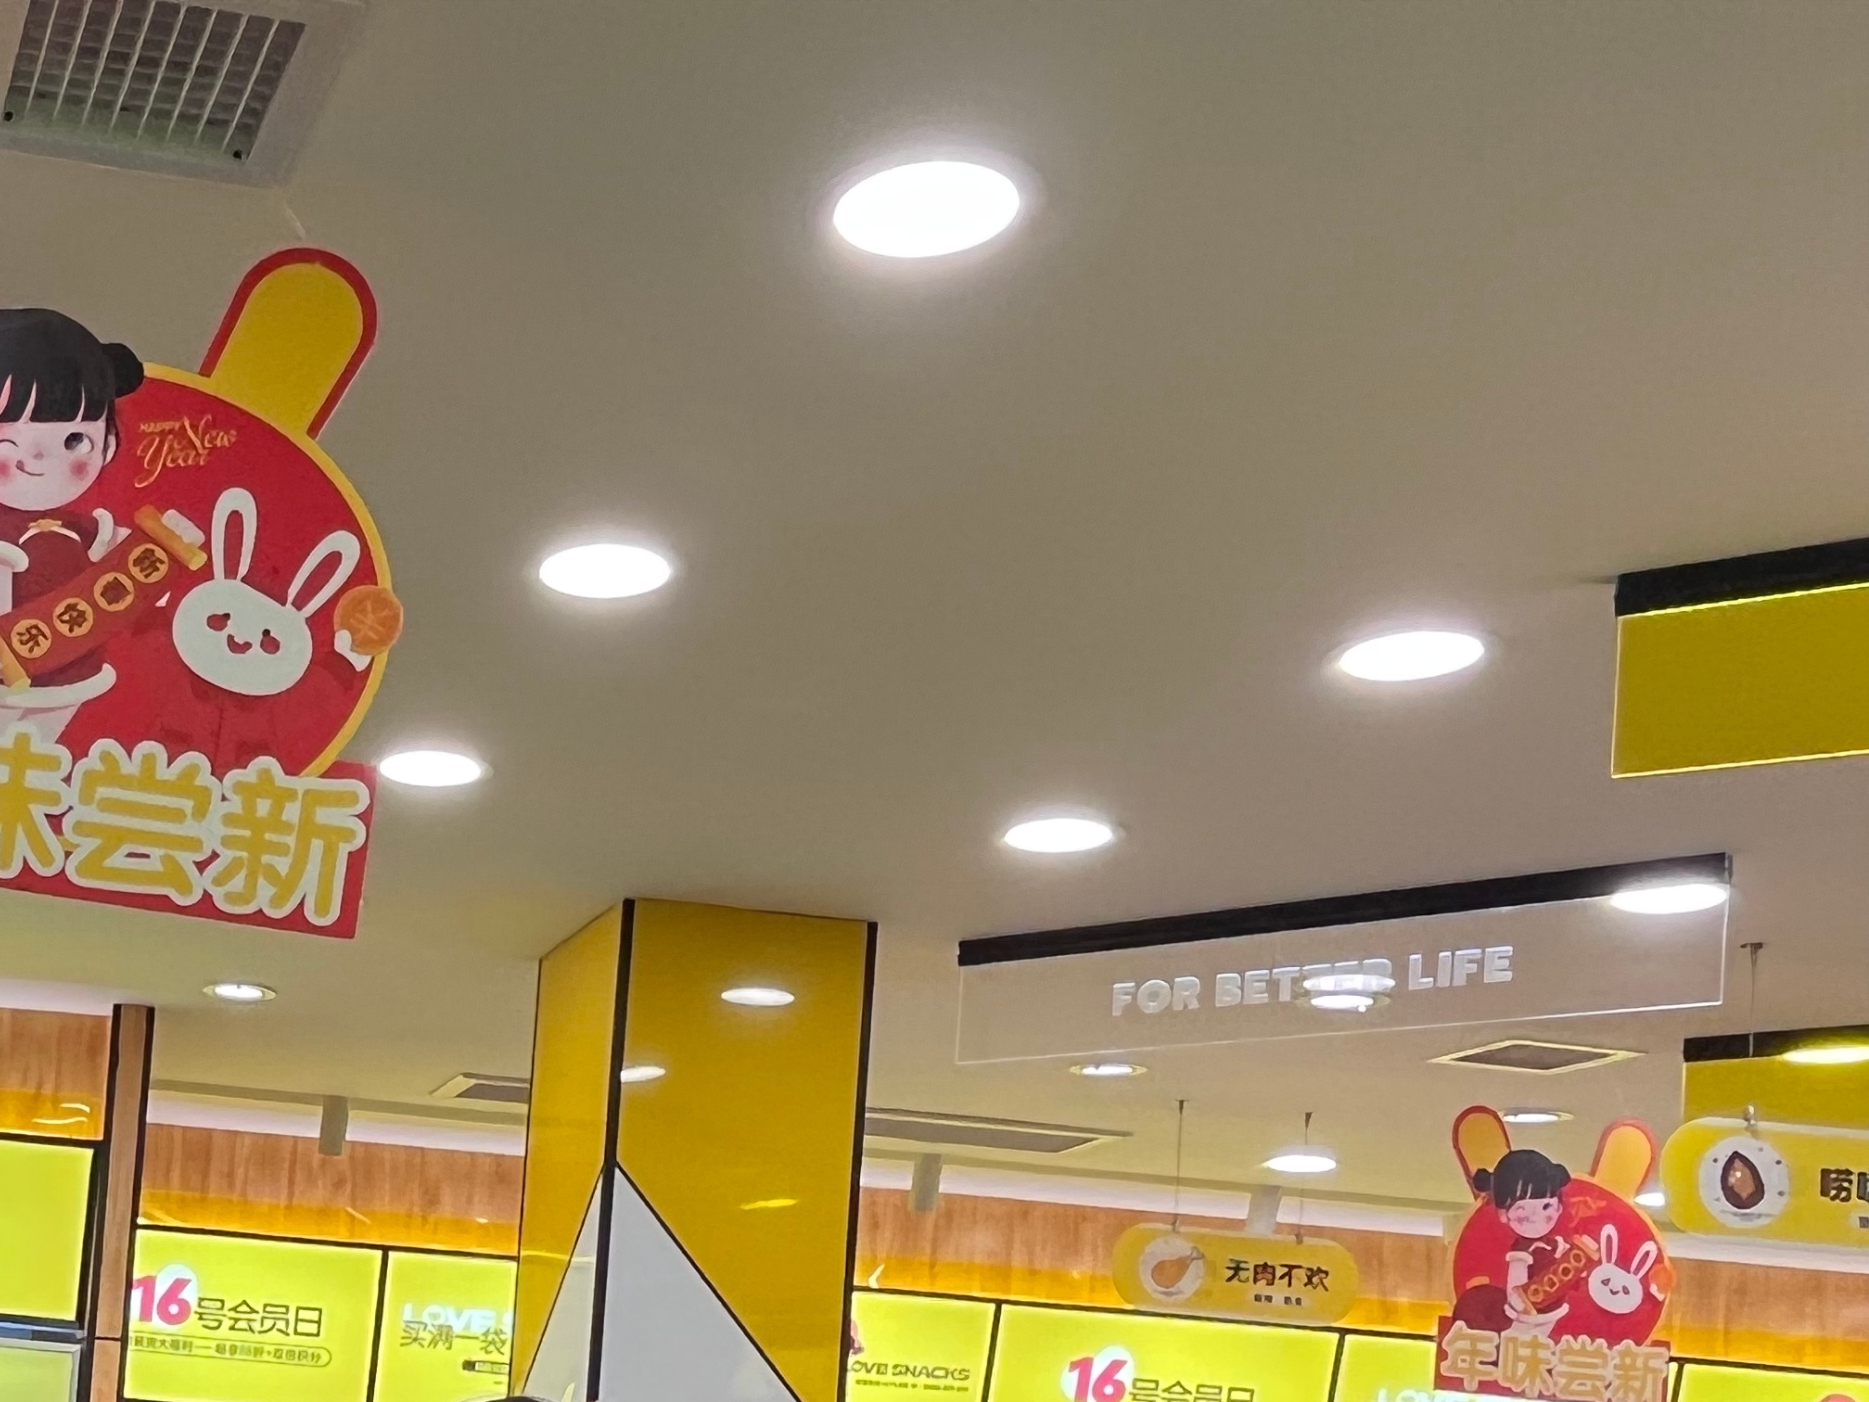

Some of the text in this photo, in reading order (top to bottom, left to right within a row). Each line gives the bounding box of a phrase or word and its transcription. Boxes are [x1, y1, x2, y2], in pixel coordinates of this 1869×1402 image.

[134, 434, 210, 488] Year
[1112, 976, 1200, 1016] FOR
[1409, 945, 1513, 990] LIFE
[1225, 1258, 1329, 1291] 无肉不欢
[402, 1302, 496, 1334] LOVE
[848, 1360, 970, 1381] OVE SNACKS
